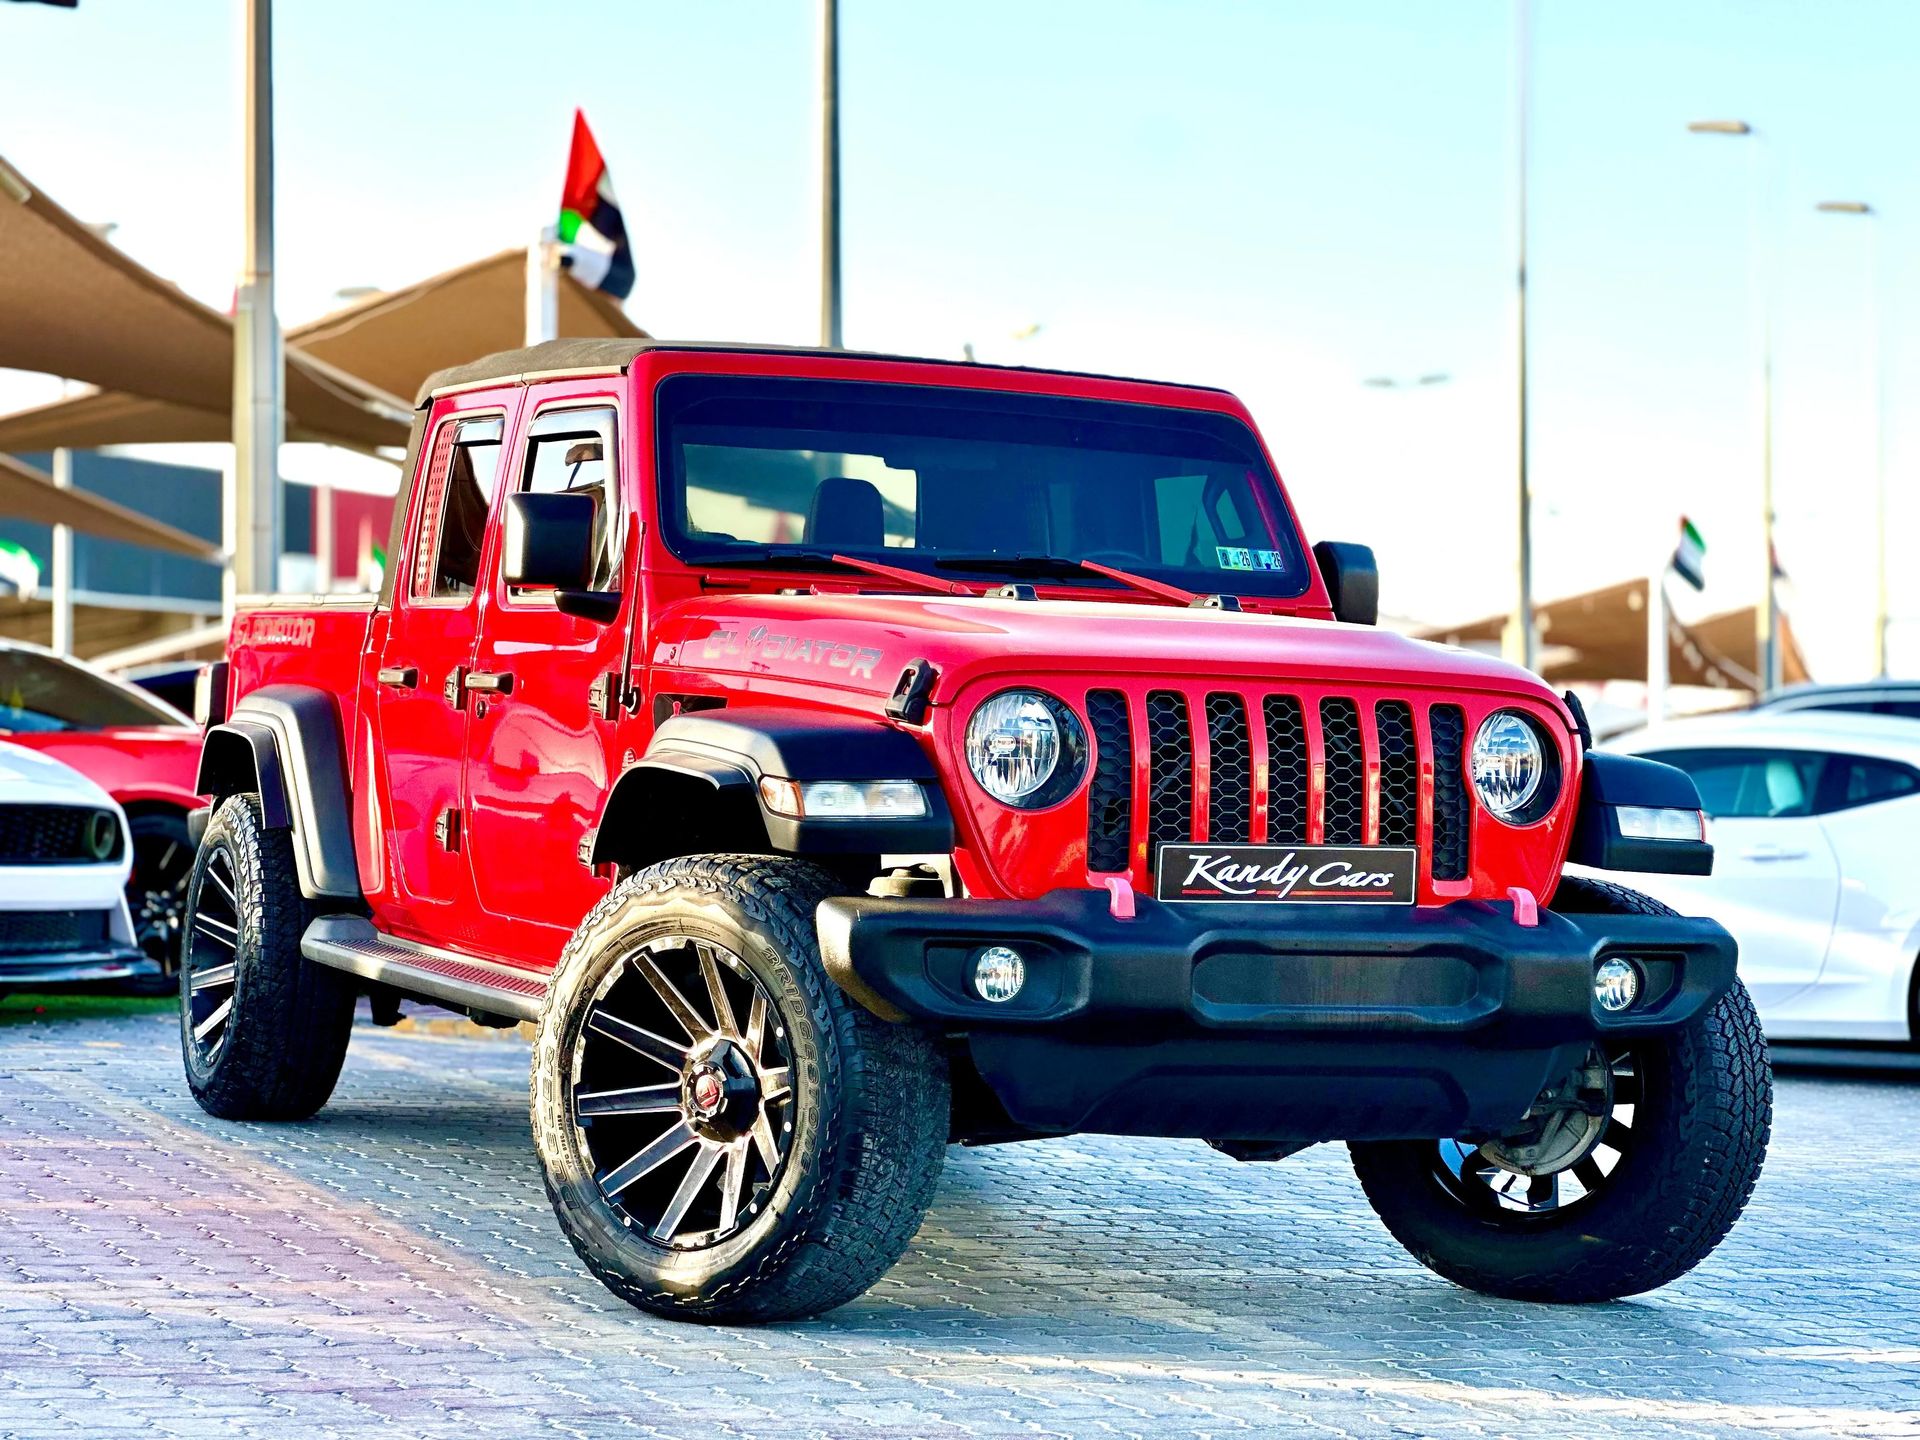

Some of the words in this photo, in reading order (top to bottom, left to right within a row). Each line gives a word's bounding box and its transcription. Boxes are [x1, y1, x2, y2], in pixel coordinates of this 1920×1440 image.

[1240, 551, 1251, 567] 26
[1182, 852, 1309, 899] Kandy
[1309, 861, 1394, 888] Cars
[762, 947, 821, 1176] BRIDGESTONE
